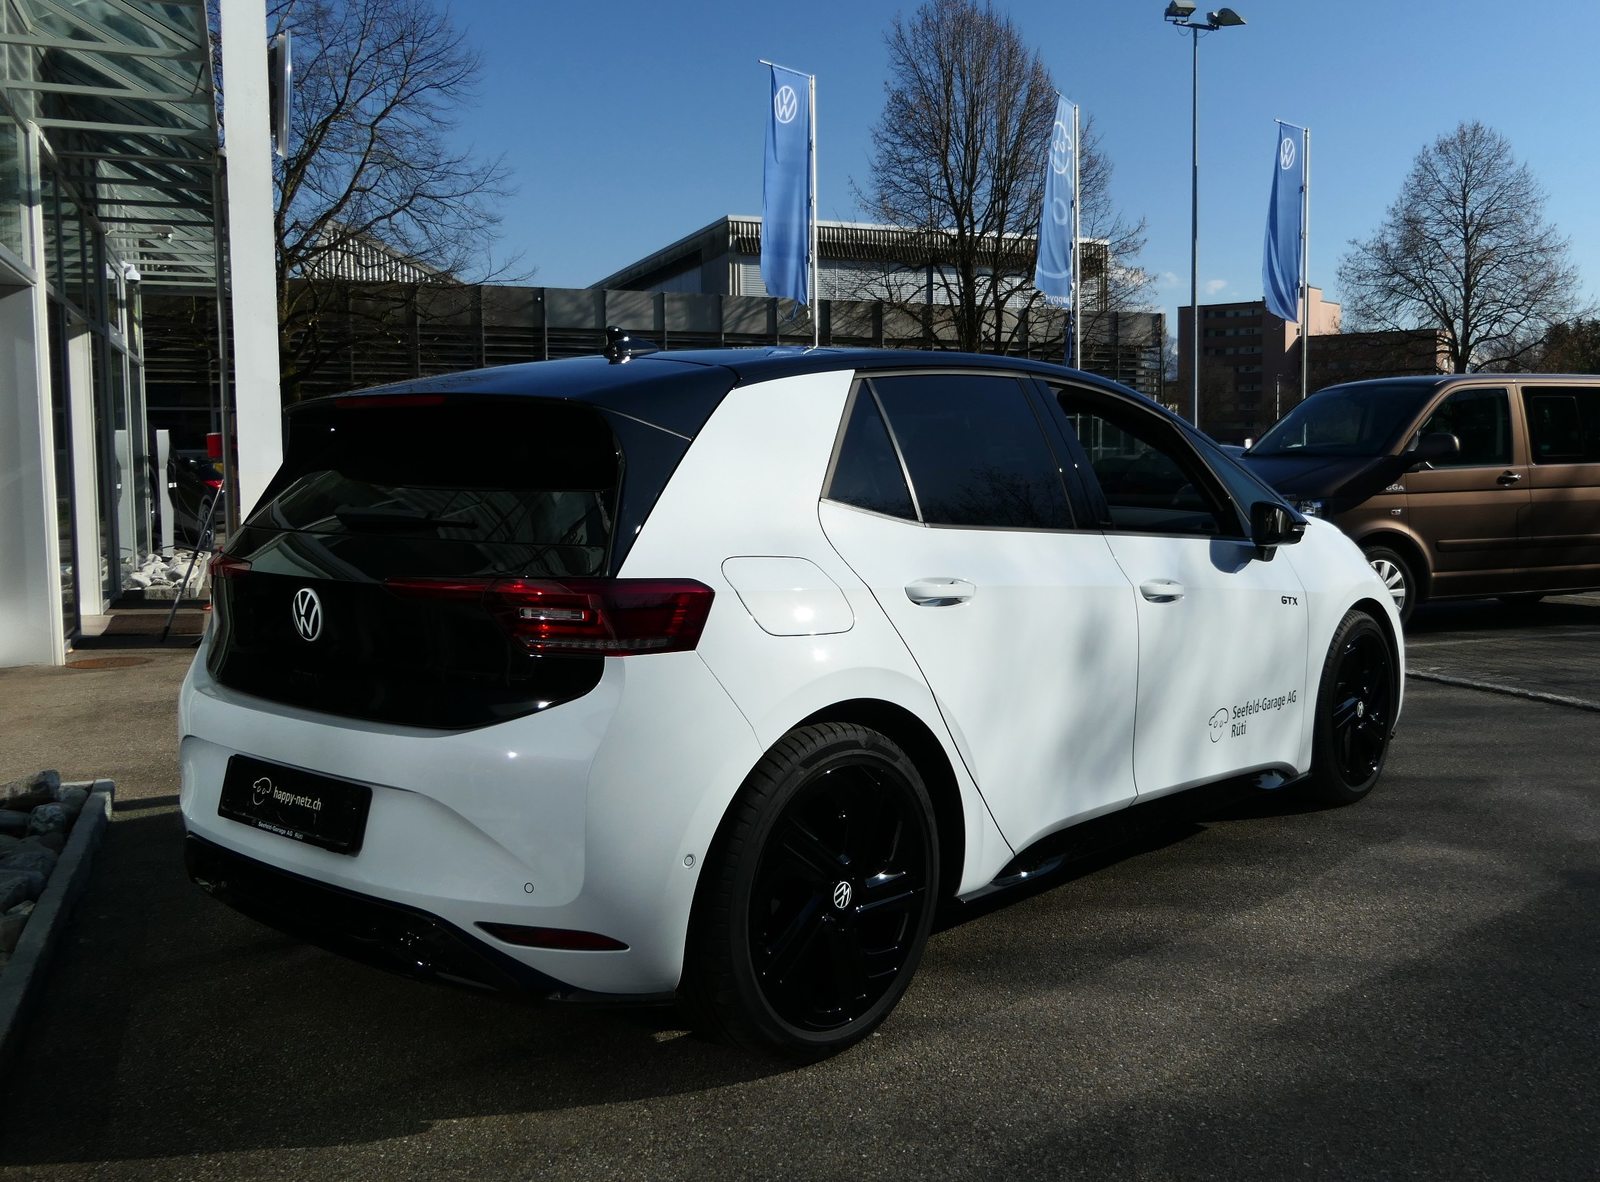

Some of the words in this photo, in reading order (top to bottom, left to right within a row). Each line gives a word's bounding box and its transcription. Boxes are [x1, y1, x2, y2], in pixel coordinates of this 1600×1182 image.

[1280, 595, 1298, 606] GTX
[292, 587, 322, 642] VW
[1231, 694, 1286, 719] Seefeld-Garage
[1286, 690, 1297, 704] AG
[1231, 720, 1247, 738] Rüti
[272, 786, 322, 811] happy-netz.ch
